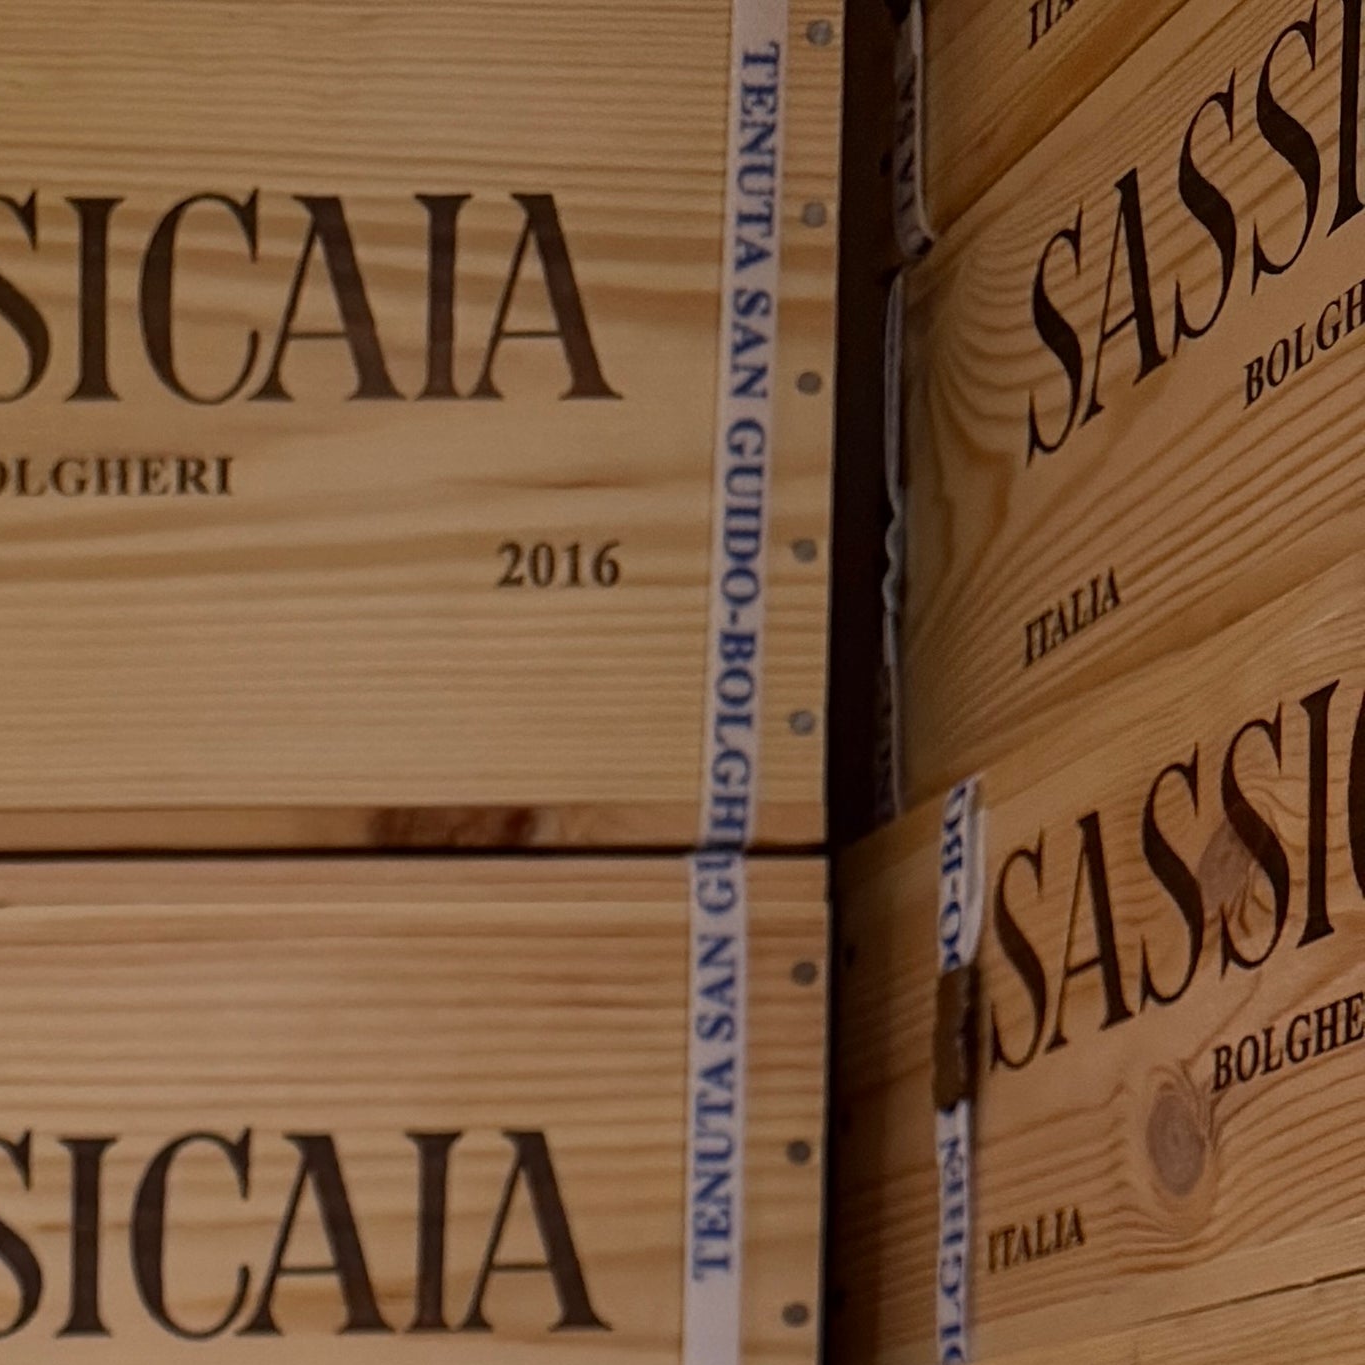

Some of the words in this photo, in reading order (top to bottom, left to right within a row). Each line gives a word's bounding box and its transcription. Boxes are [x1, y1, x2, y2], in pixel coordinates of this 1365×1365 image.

[735, 40, 781, 272] TENUTA
[730, 288, 771, 399] SAN
[497, 540, 622, 590] 2016
[1024, 567, 1121, 668] ITALIA
[989, 680, 1365, 1073] SASSI
[696, 934, 736, 1042] SAN
[693, 1058, 736, 1280] TENUTA
[987, 1205, 1086, 1275] ITALIA
